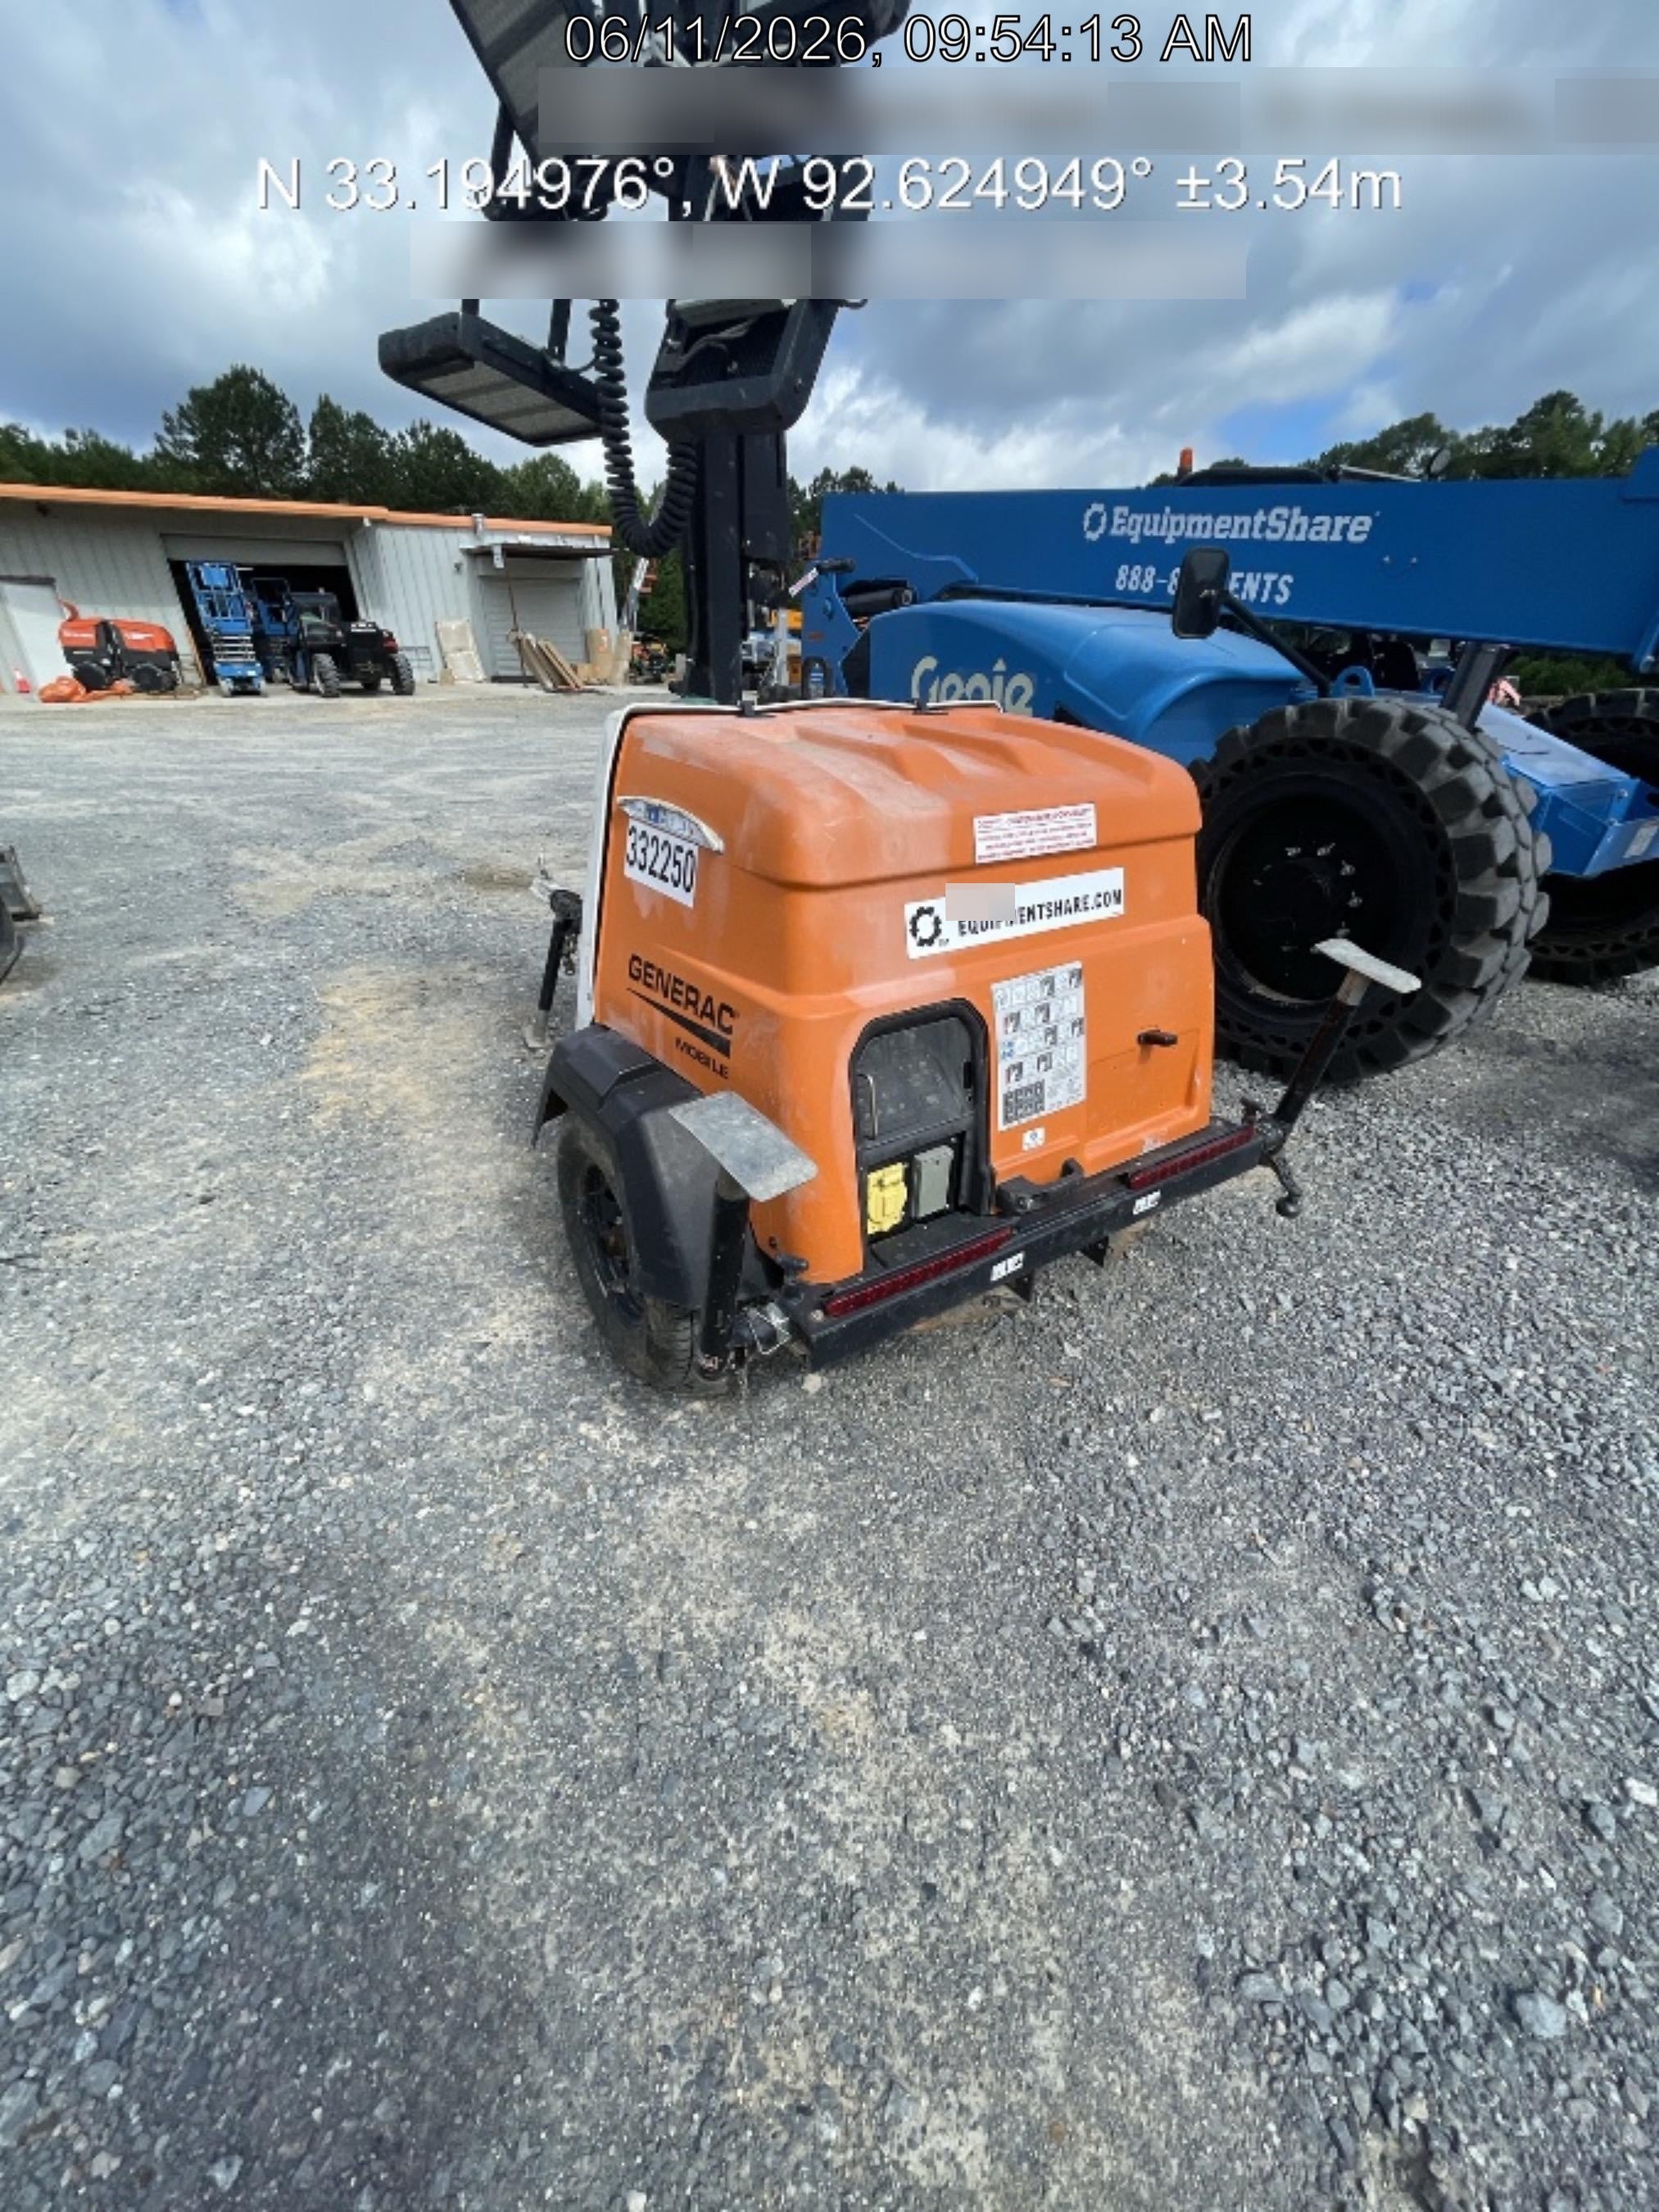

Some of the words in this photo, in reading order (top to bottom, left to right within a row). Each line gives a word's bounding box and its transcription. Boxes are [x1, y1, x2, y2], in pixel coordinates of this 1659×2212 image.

[1109, 505, 1373, 544] EquipmentShare
[1114, 564, 1294, 605] 888-8ENTS
[911, 655, 1035, 717] Genie
[626, 825, 696, 894] 332250
[958, 888, 1123, 937] EQUIENTSHARE.COM
[628, 953, 737, 1036] GENERAC
[674, 1036, 730, 1081] MOBILE
